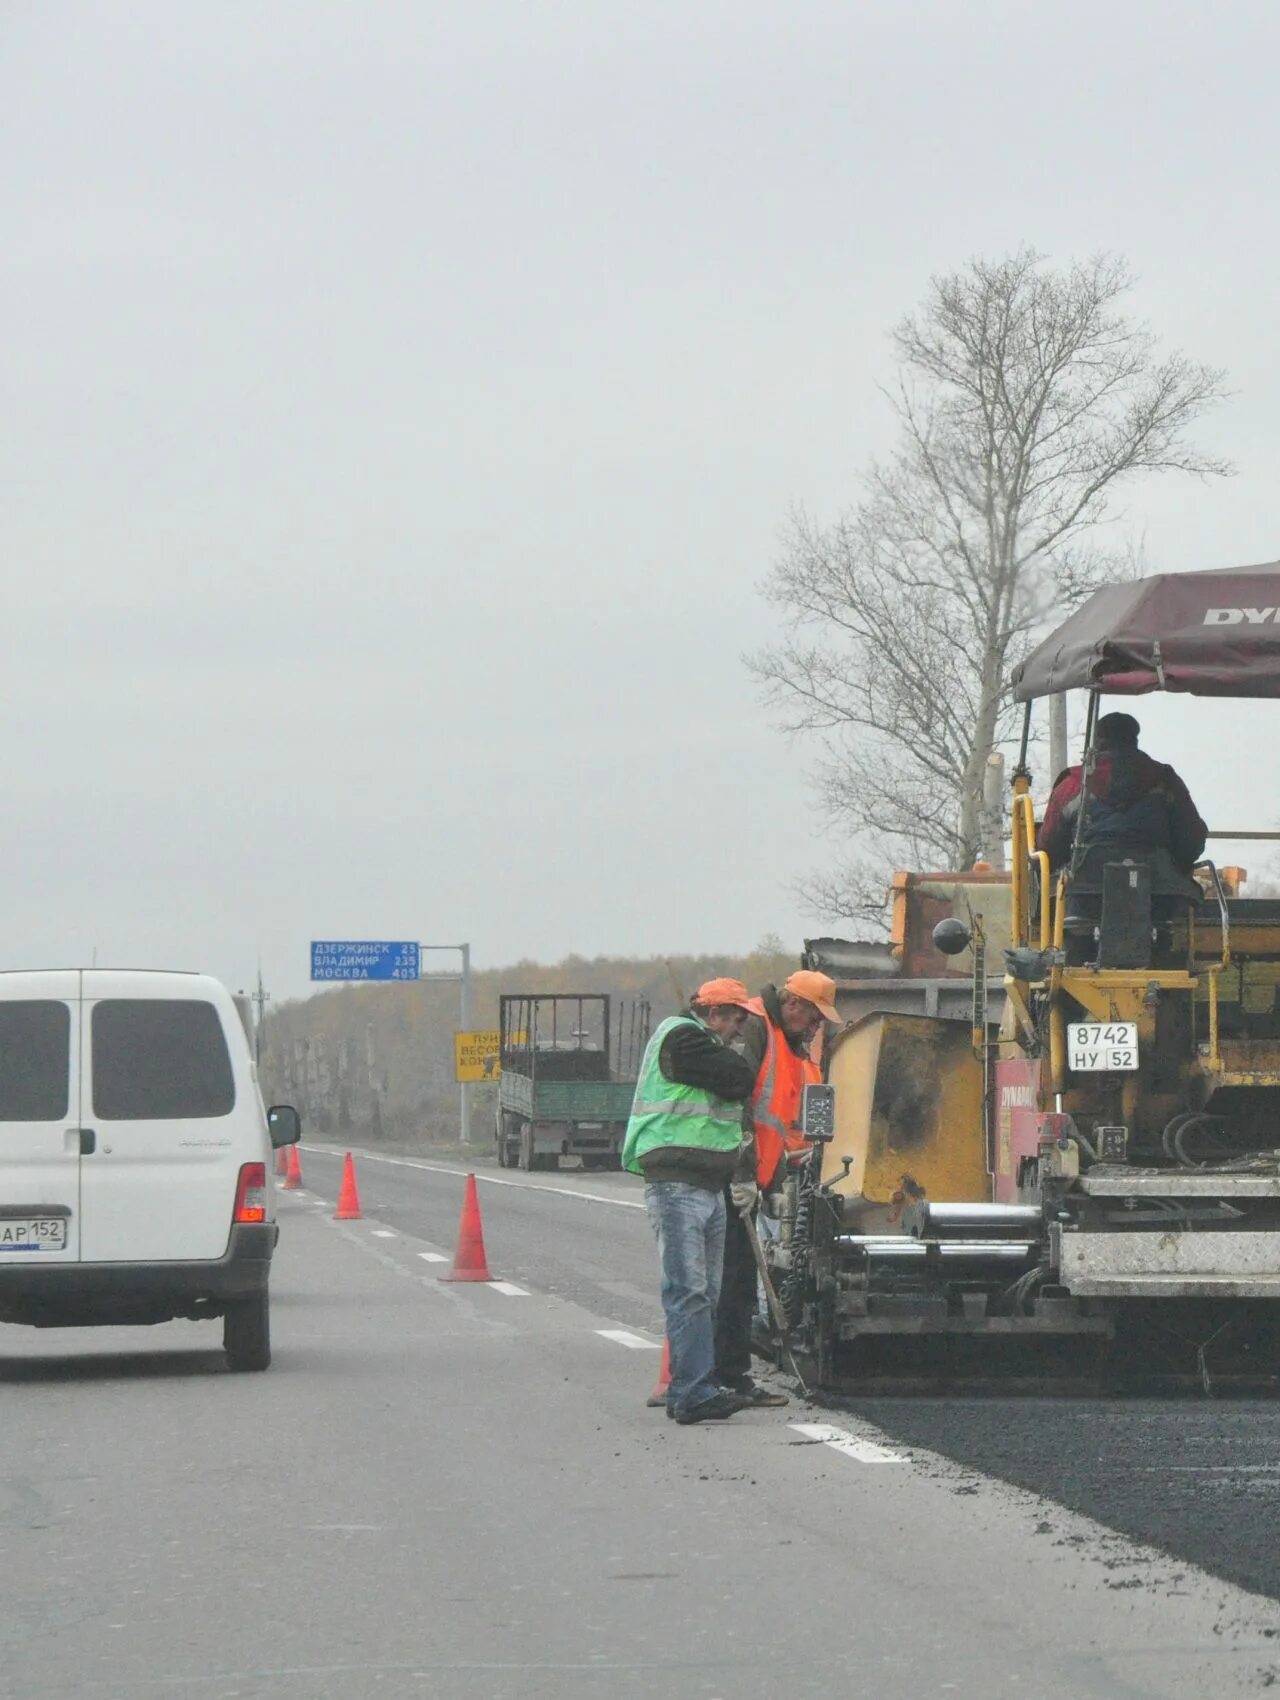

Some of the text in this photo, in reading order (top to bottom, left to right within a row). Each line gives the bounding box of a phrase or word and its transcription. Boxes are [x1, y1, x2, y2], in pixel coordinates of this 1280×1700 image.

[314, 943, 417, 954] ДЗЕРЖИНСК 25
[314, 956, 417, 966] ВЛАДИМИР 235
[314, 968, 416, 978] МОСКВА 405
[473, 1034, 500, 1044] ПУН
[1077, 1026, 1129, 1045] 8742
[1075, 1051, 1133, 1067] НУ 52
[0, 1222, 59, 1242] АР 152
